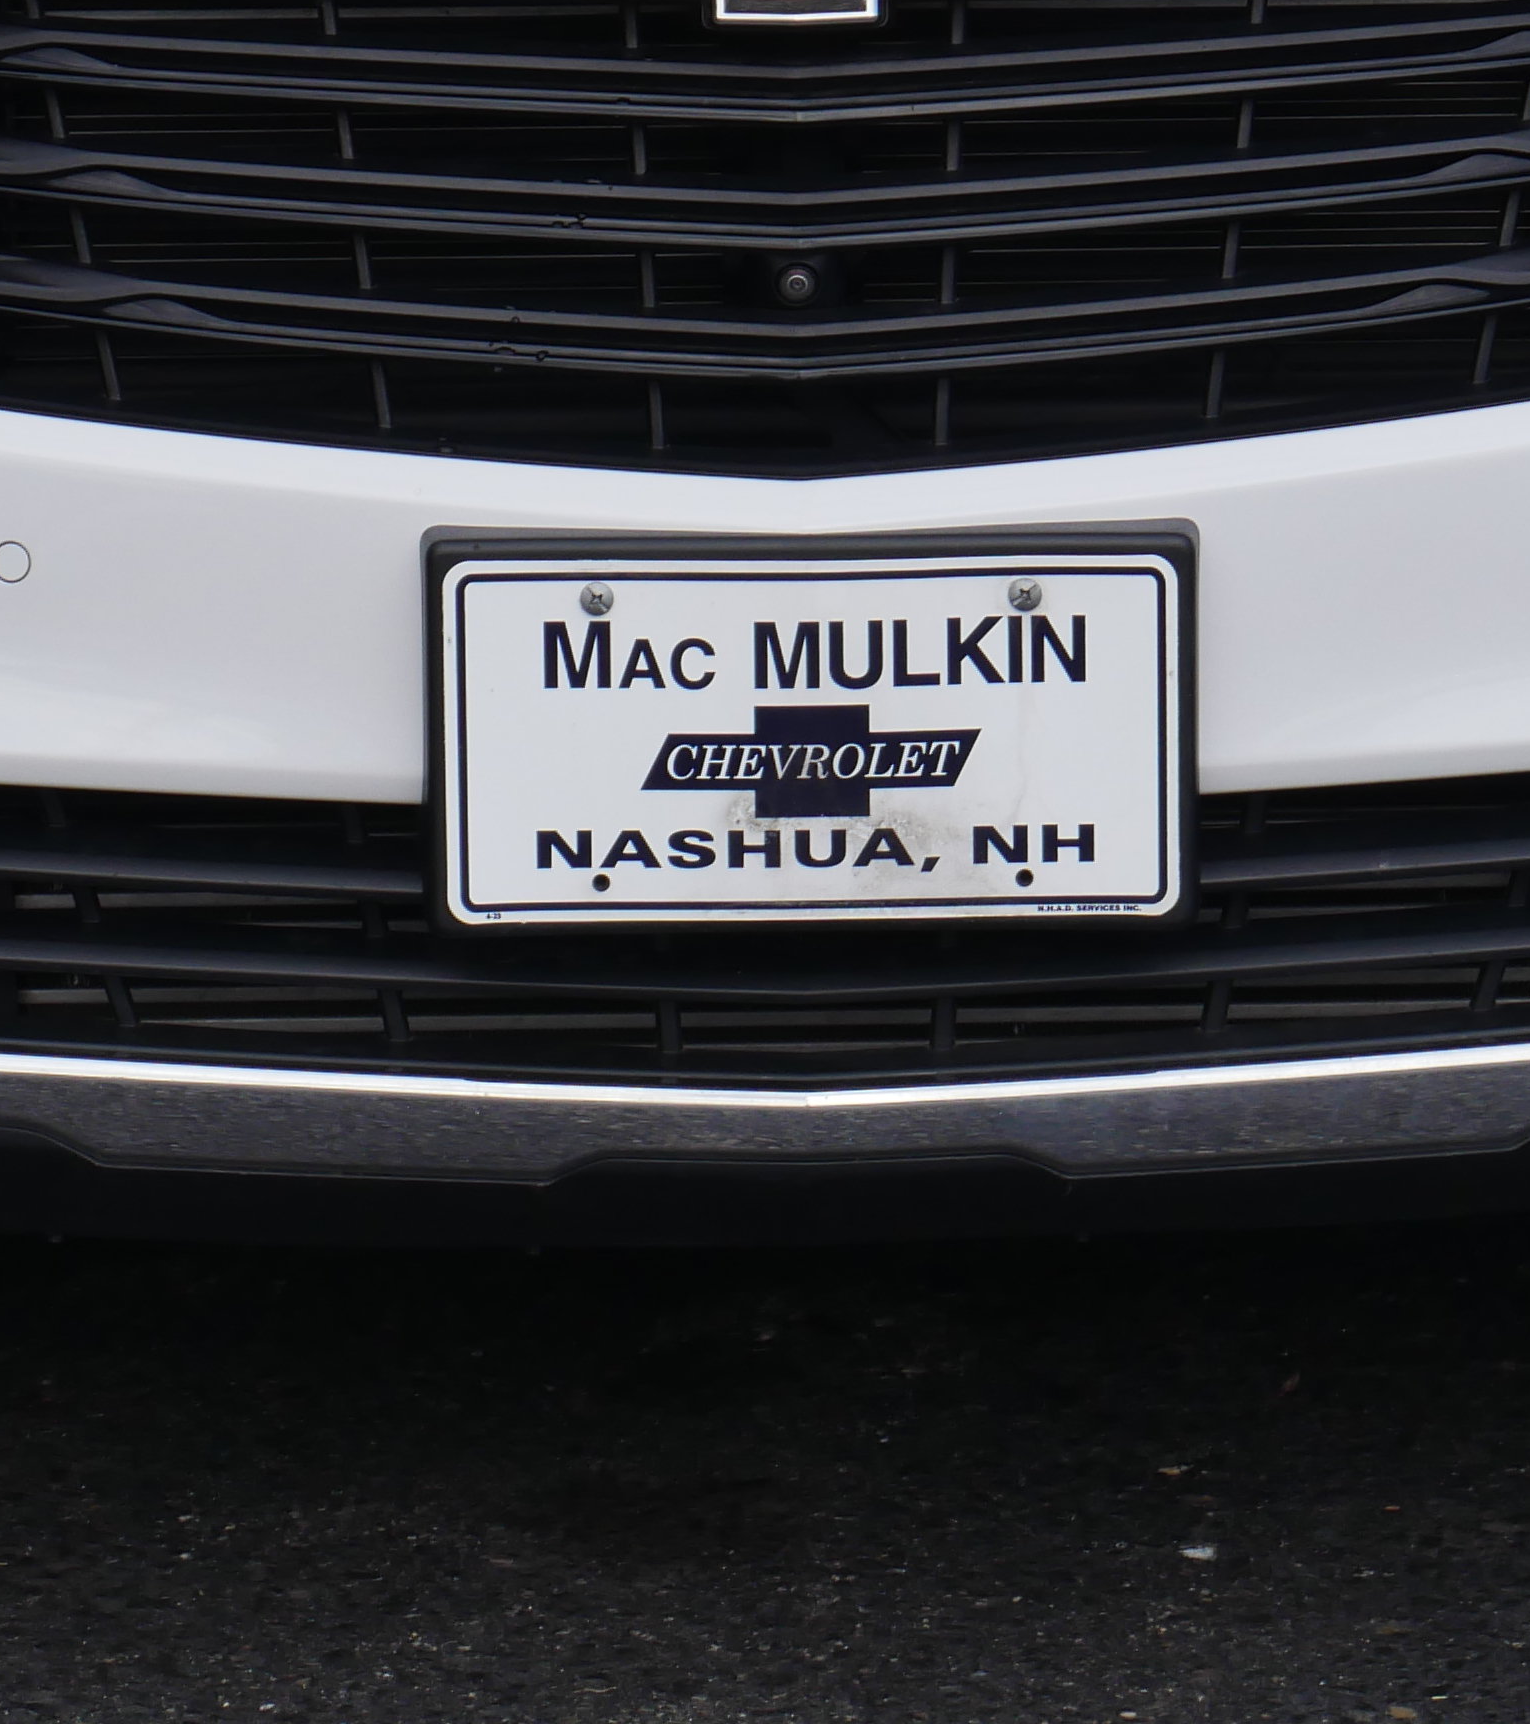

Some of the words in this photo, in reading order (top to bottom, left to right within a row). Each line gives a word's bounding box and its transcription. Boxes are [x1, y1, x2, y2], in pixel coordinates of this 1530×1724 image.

[753, 614, 1086, 689] MULKIN
[666, 740, 961, 781] CHEVROLET
[536, 828, 941, 872] NASHUA,
[973, 823, 1096, 864] NH
[1076, 904, 1120, 912] SERVICES
[1123, 904, 1142, 912] INC.
